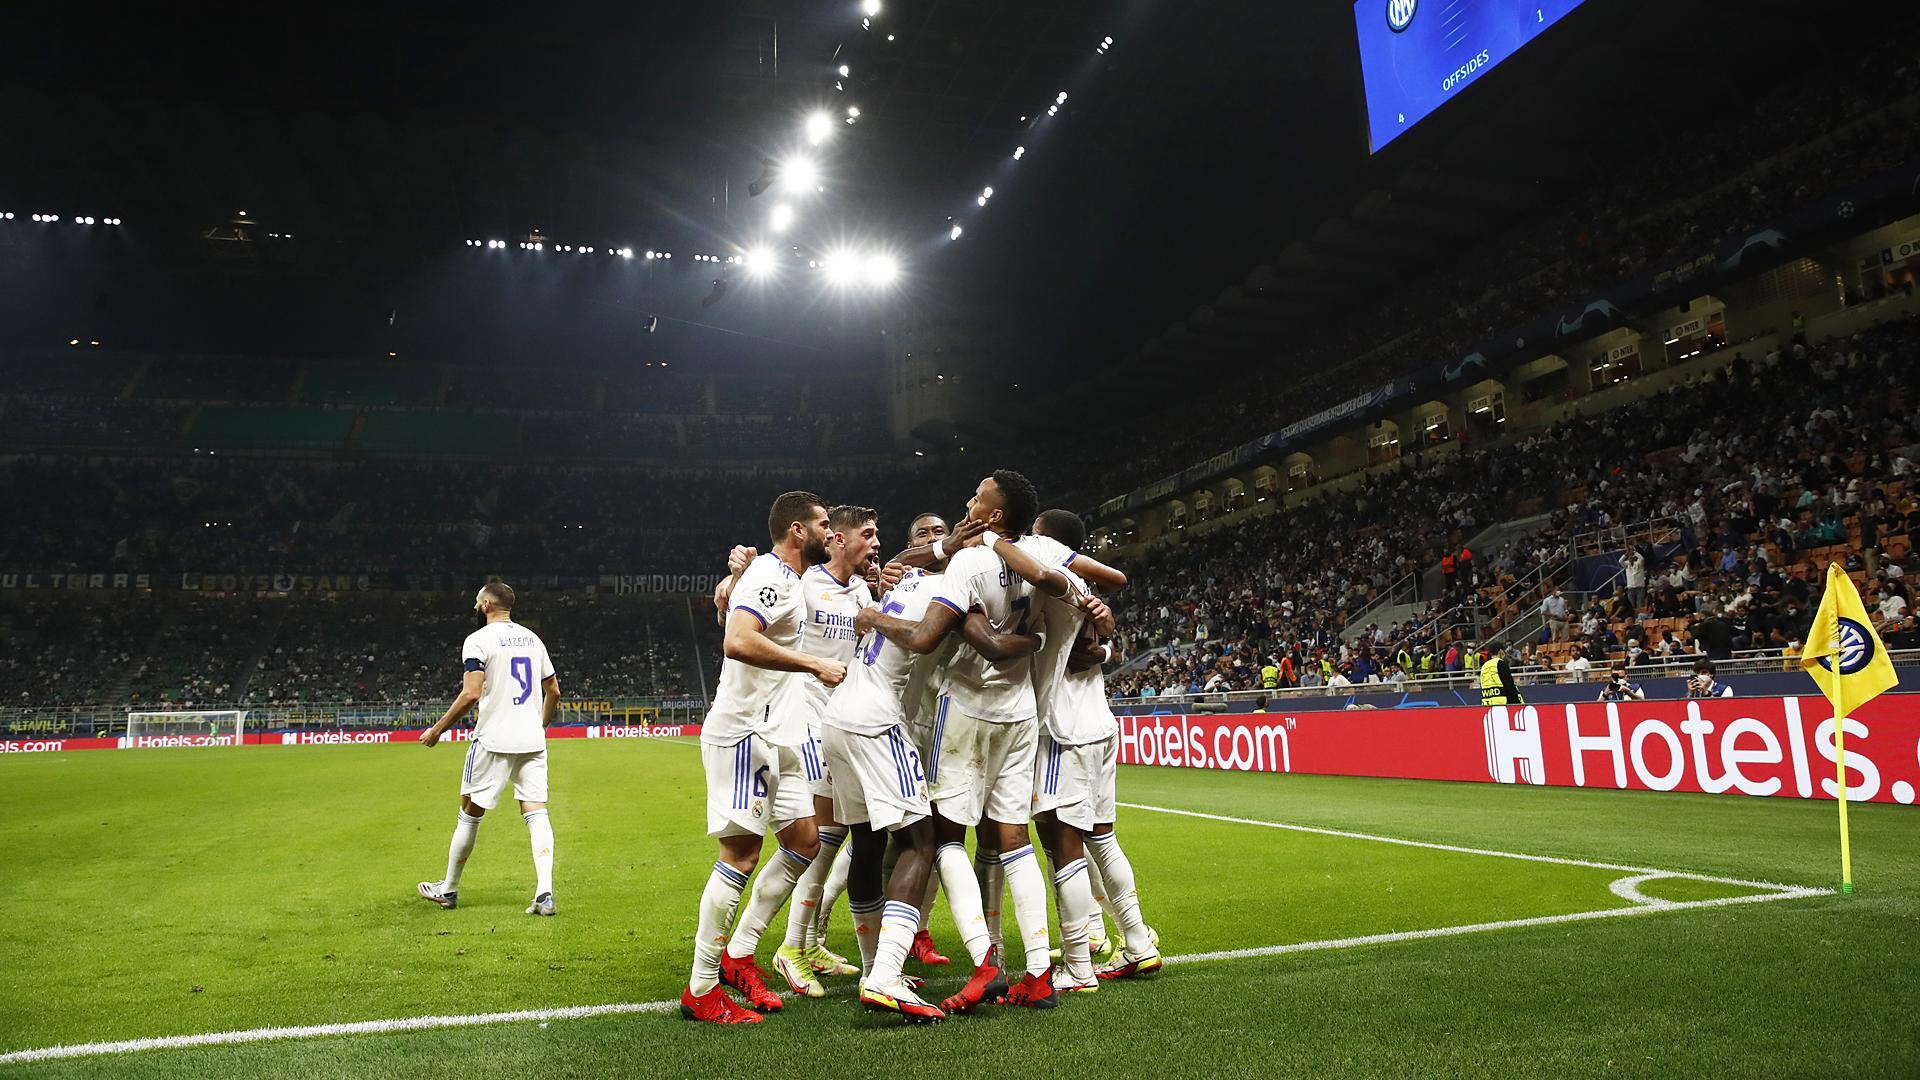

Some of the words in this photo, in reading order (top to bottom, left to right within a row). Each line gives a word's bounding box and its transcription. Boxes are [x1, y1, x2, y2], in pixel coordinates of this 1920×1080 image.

[1442, 49, 1490, 92] OFFSIDES
[1536, 9, 1544, 23] 1
[815, 609, 857, 629] Emira
[823, 627, 838, 638] FLY
[511, 656, 533, 705] 9
[302, 729, 388, 745] Hotels.com
[753, 764, 770, 798] 6
